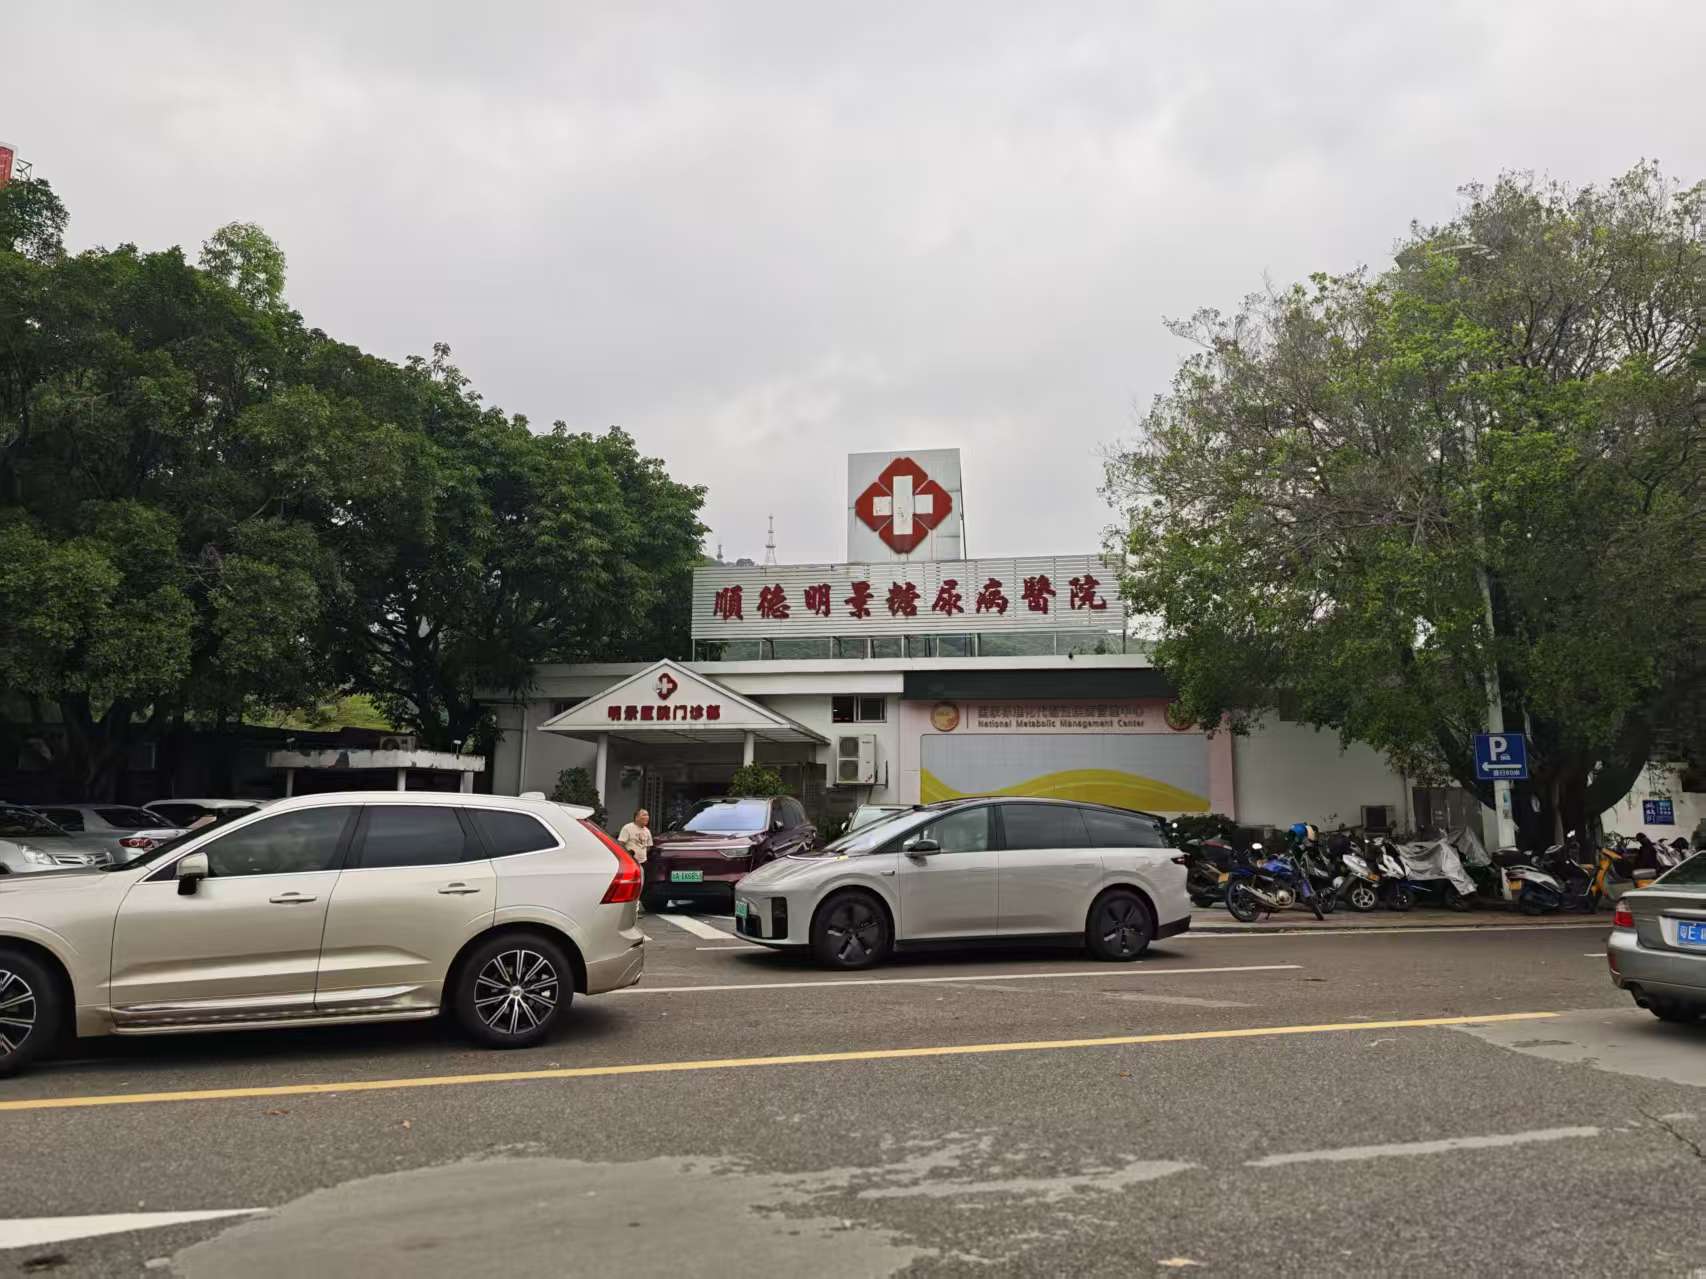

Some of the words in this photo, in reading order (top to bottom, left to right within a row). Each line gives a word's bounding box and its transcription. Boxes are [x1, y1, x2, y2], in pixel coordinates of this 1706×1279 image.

[608, 704, 720, 721] 明景医院门诊部
[978, 719, 1012, 728] National
[1016, 719, 1056, 728] Metabolic
[1060, 719, 1113, 730] Management
[1117, 719, 1145, 728] Center
[1489, 736, 1507, 761] P
